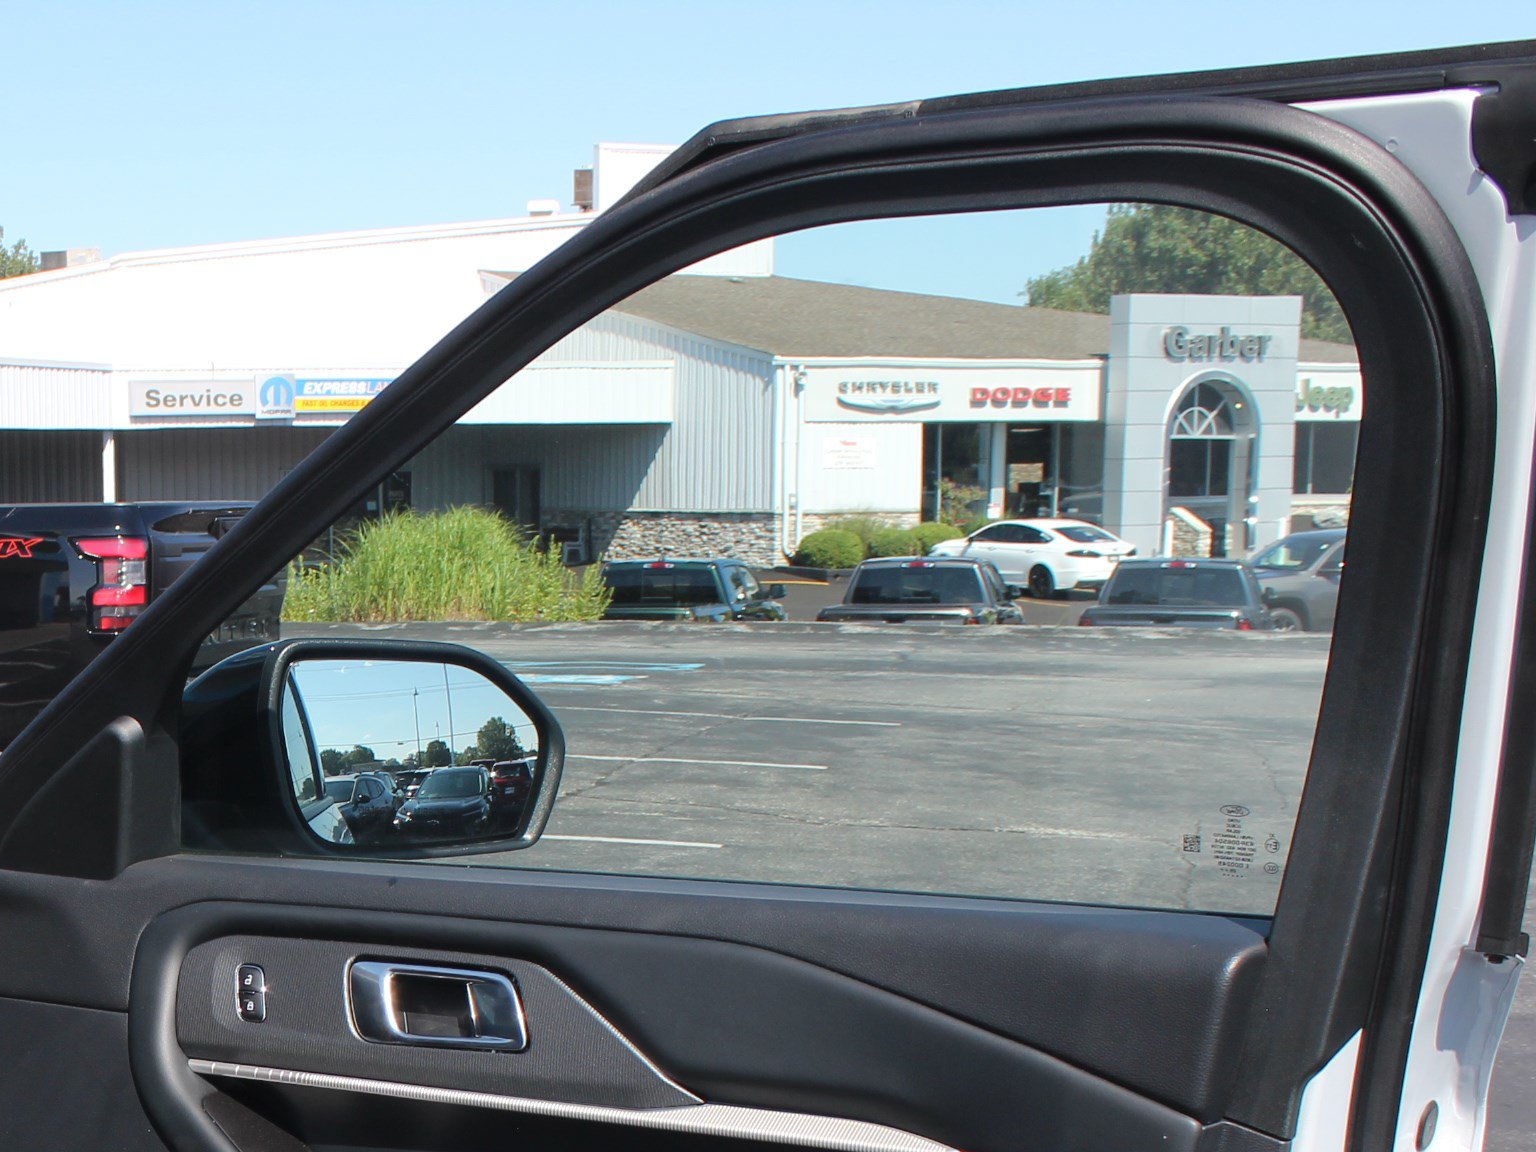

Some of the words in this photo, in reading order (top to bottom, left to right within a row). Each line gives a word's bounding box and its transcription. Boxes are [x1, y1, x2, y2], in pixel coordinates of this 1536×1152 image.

[1164, 326, 1272, 361] Garber
[838, 381, 939, 395] CHRYSLER
[969, 387, 1072, 405] DODGE
[1296, 378, 1353, 417] Jeep
[145, 389, 243, 408] Service
